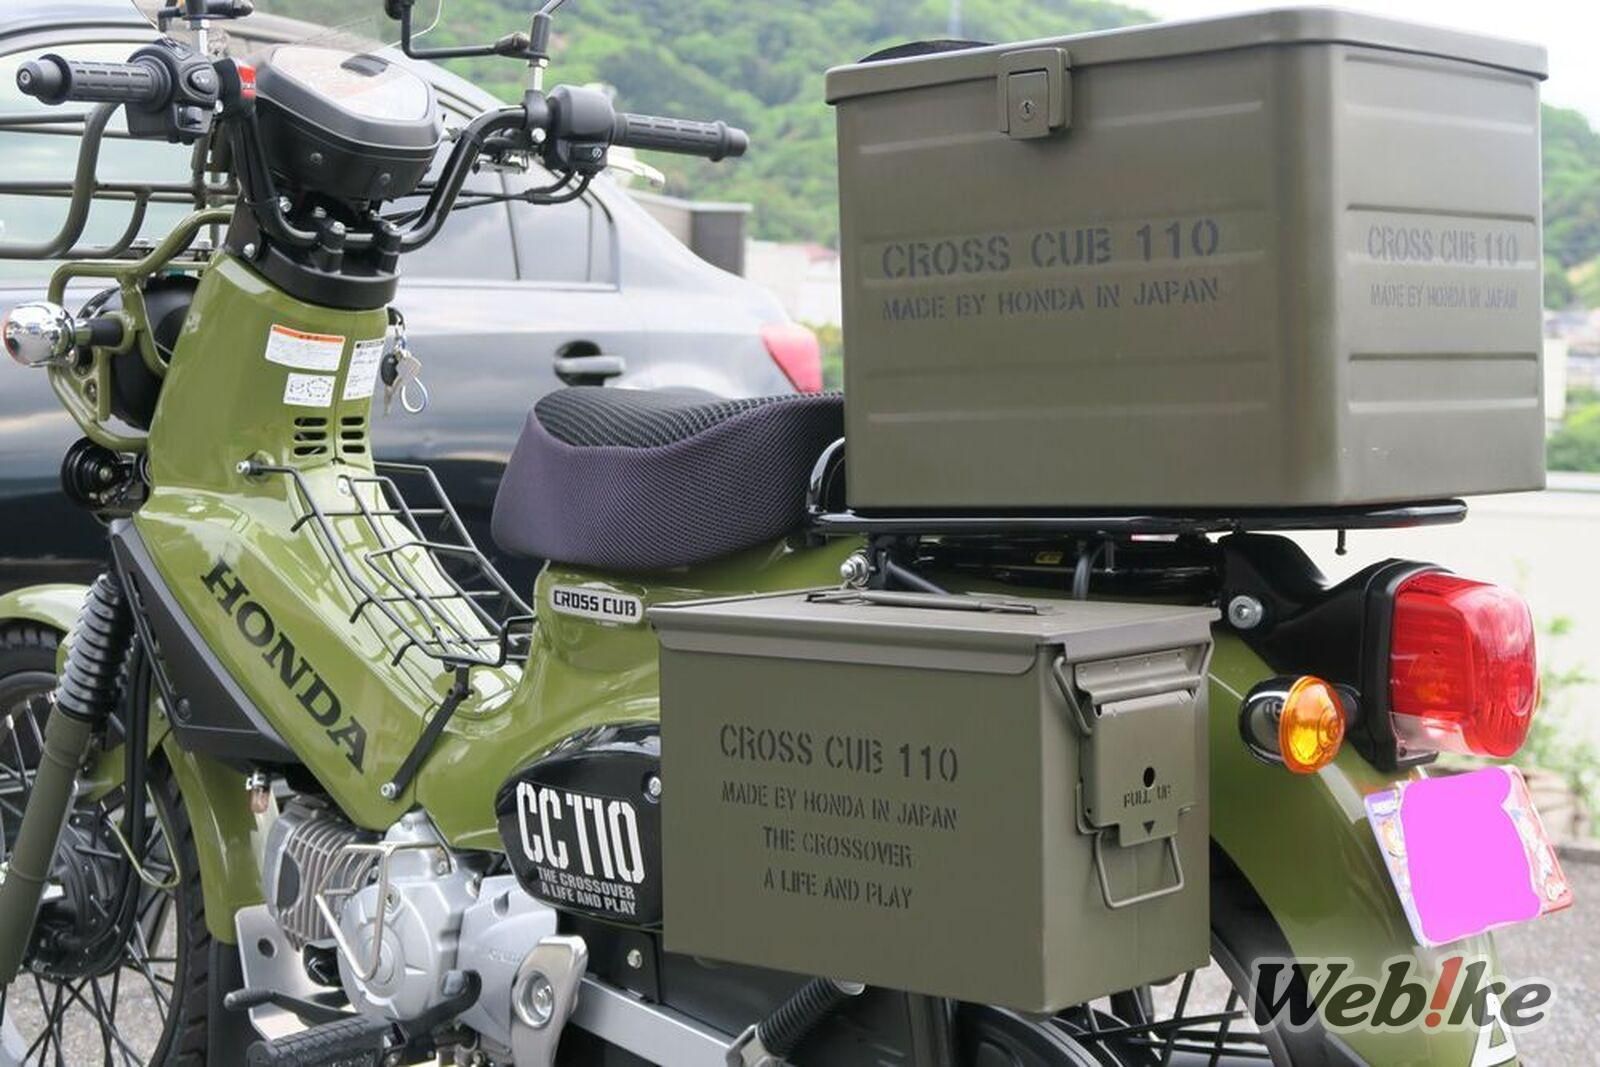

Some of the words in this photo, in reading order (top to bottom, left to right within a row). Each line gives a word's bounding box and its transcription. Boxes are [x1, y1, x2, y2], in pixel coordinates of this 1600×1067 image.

[881, 235, 1011, 279] CROSS
[1030, 226, 1112, 269] CUB
[1136, 218, 1221, 262] 110
[1368, 224, 1434, 262] CROSS
[1439, 229, 1477, 264] CUB
[1485, 229, 1519, 267] 110
[882, 295, 949, 321] MADE
[956, 293, 985, 317] BY
[998, 286, 1085, 315] HONDA
[1096, 283, 1121, 310] IN
[1133, 277, 1219, 307] JAPAN
[1369, 281, 1404, 308] MADE
[1426, 284, 1467, 309] HONDA
[1484, 287, 1519, 310] JAPAN
[553, 589, 600, 612] CROSS
[602, 597, 637, 617] CUB
[200, 558, 369, 775] HONDA
[720, 723, 813, 766] CROSS
[825, 735, 883, 774] CUB
[900, 743, 958, 782] 110
[722, 780, 769, 808] MADE
[775, 786, 797, 811] BY
[803, 790, 865, 820] HONDA
[872, 797, 890, 822] IN
[897, 803, 957, 831] JAPAN
[763, 825, 796, 852] THE
[802, 832, 913, 868] CROSSOVER
[537, 867, 557, 883] THE
[559, 874, 636, 900] CROSSOVER
[542, 882, 551, 896] A
[552, 885, 574, 901] LIFE
[576, 890, 603, 908] AND
[605, 899, 636, 915] PLAY
[763, 866, 775, 890] A
[780, 869, 818, 896] LIFE
[823, 876, 860, 902] AND
[866, 881, 913, 909] PLAY
